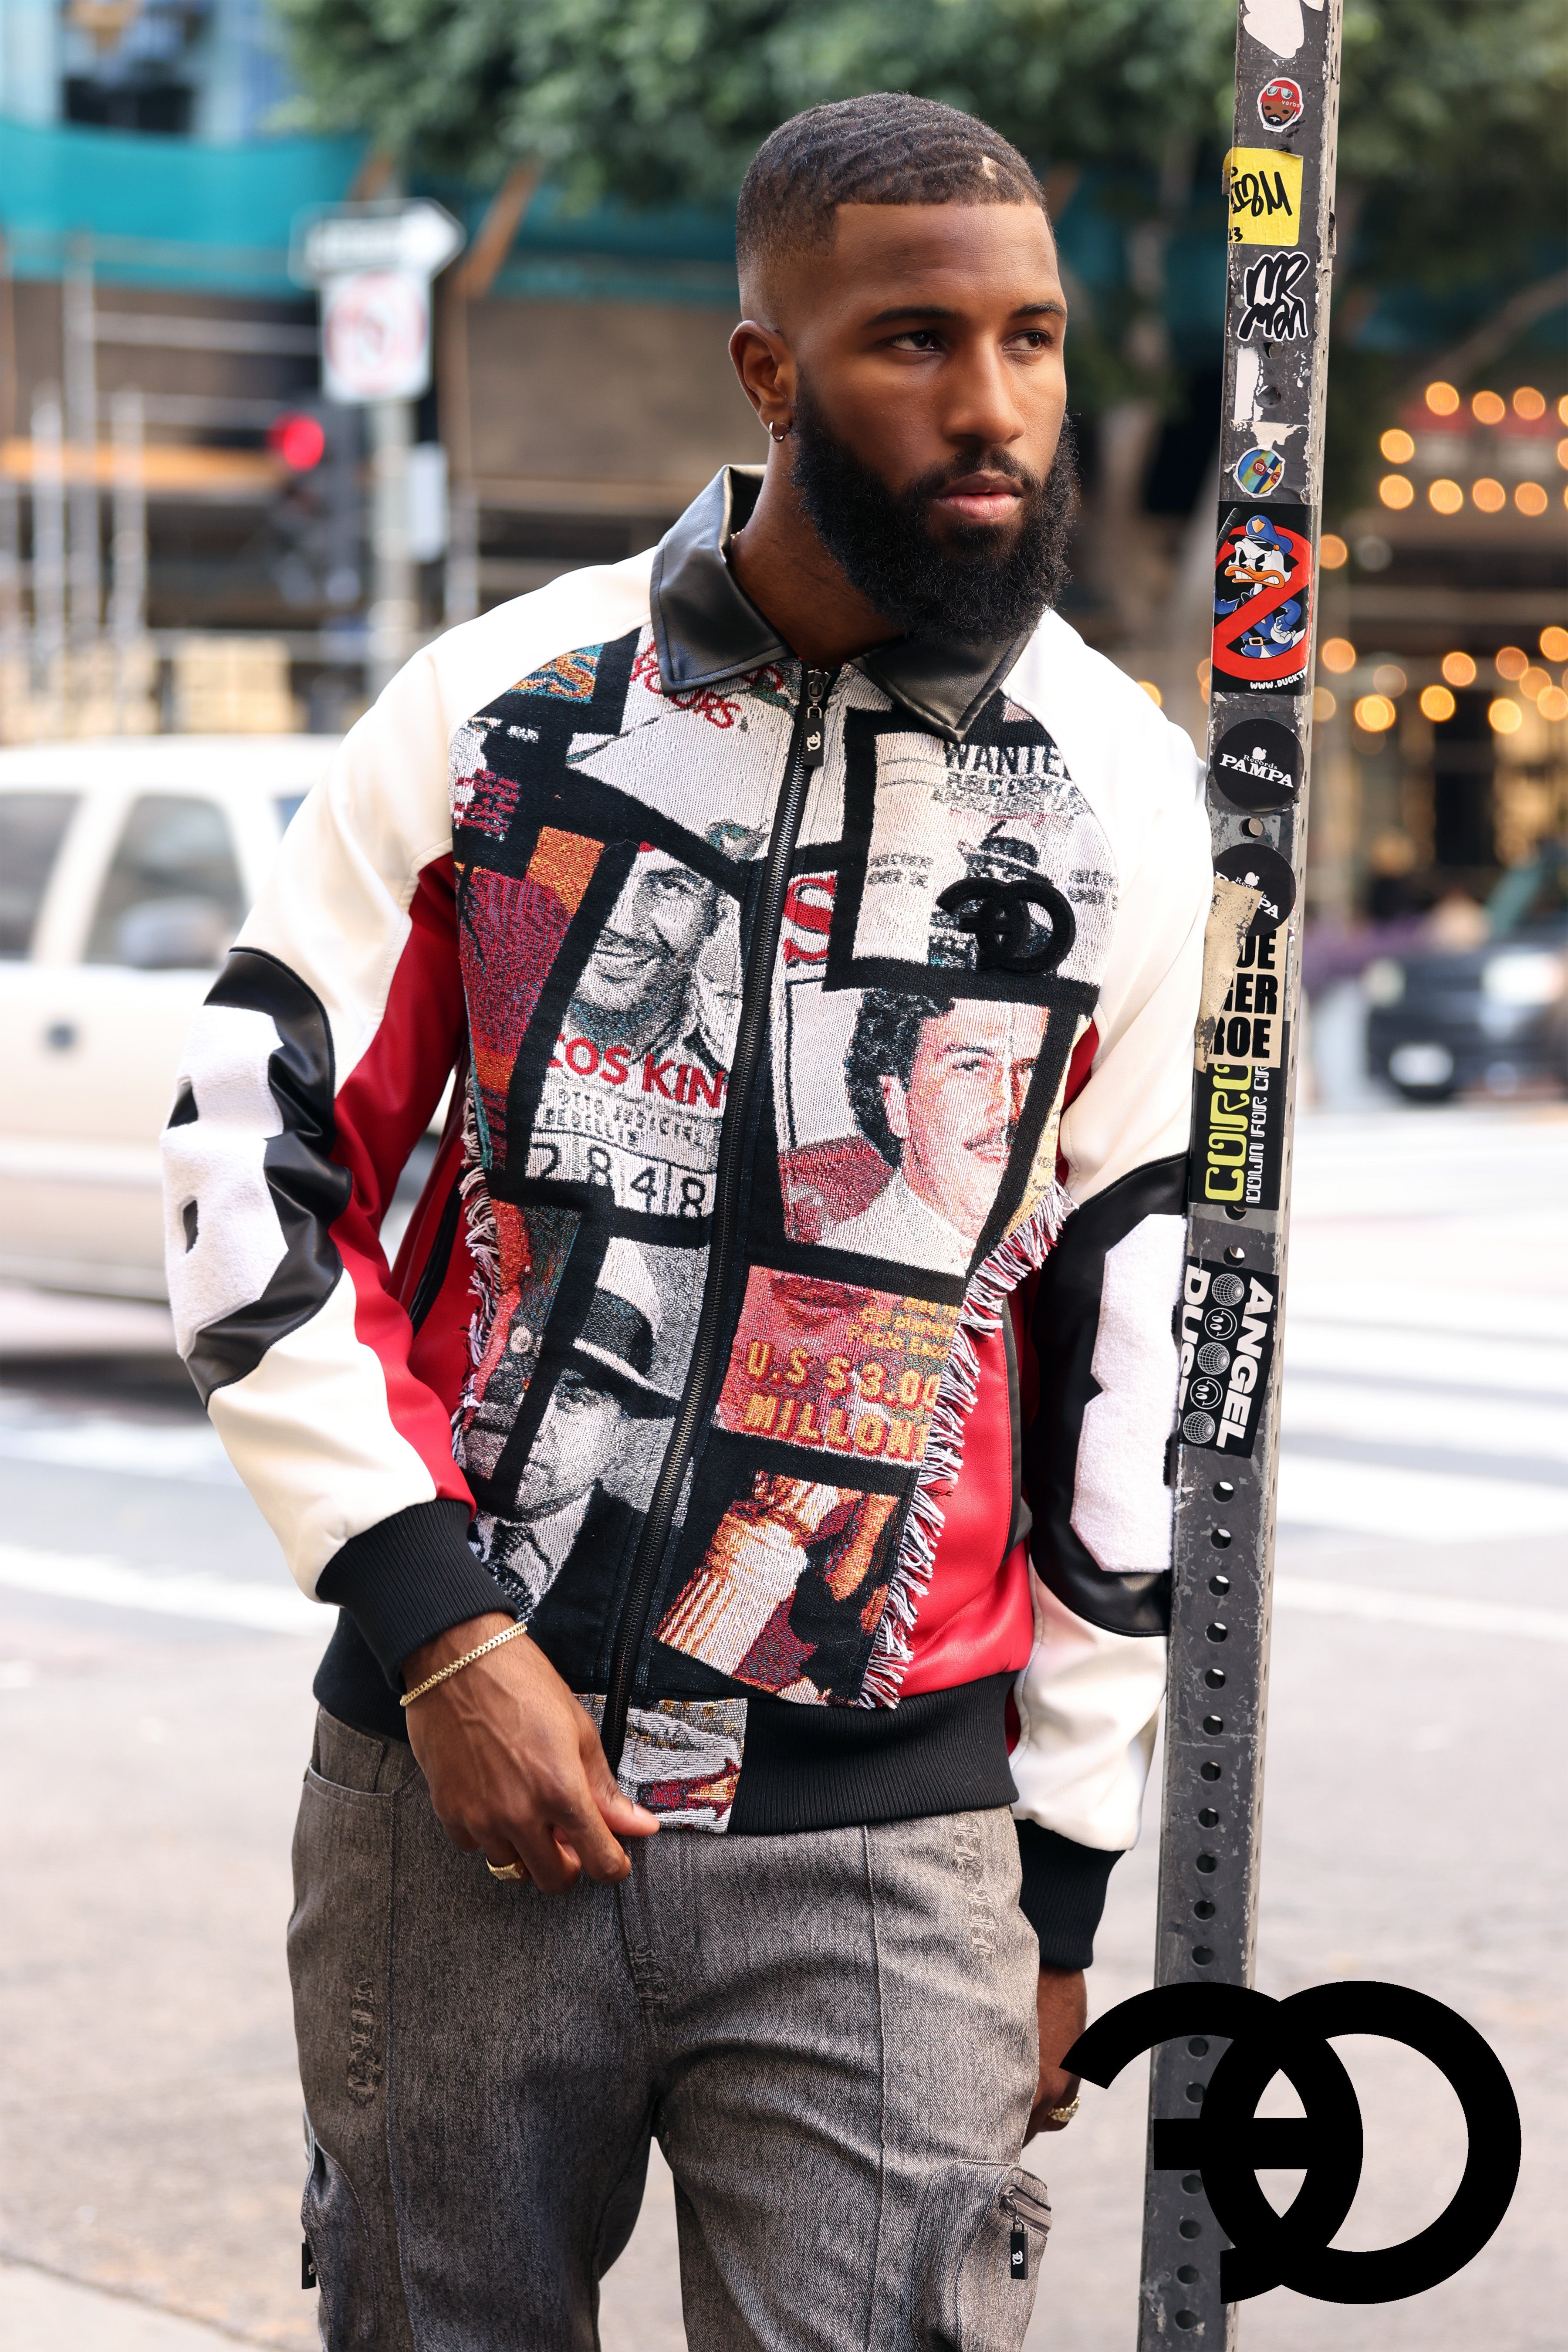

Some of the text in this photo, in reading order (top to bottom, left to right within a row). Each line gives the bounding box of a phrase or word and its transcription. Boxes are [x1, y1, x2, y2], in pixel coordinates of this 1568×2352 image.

[945, 744, 1074, 781] WANTE
[1219, 753, 1294, 788] PAMPA
[1243, 754, 1278, 770] Records
[1220, 973, 1278, 1015] ER
[1250, 1096, 1267, 1137] FOR
[1246, 1142, 1264, 1204] DOWN
[1216, 1276, 1274, 1448] ANGEL
